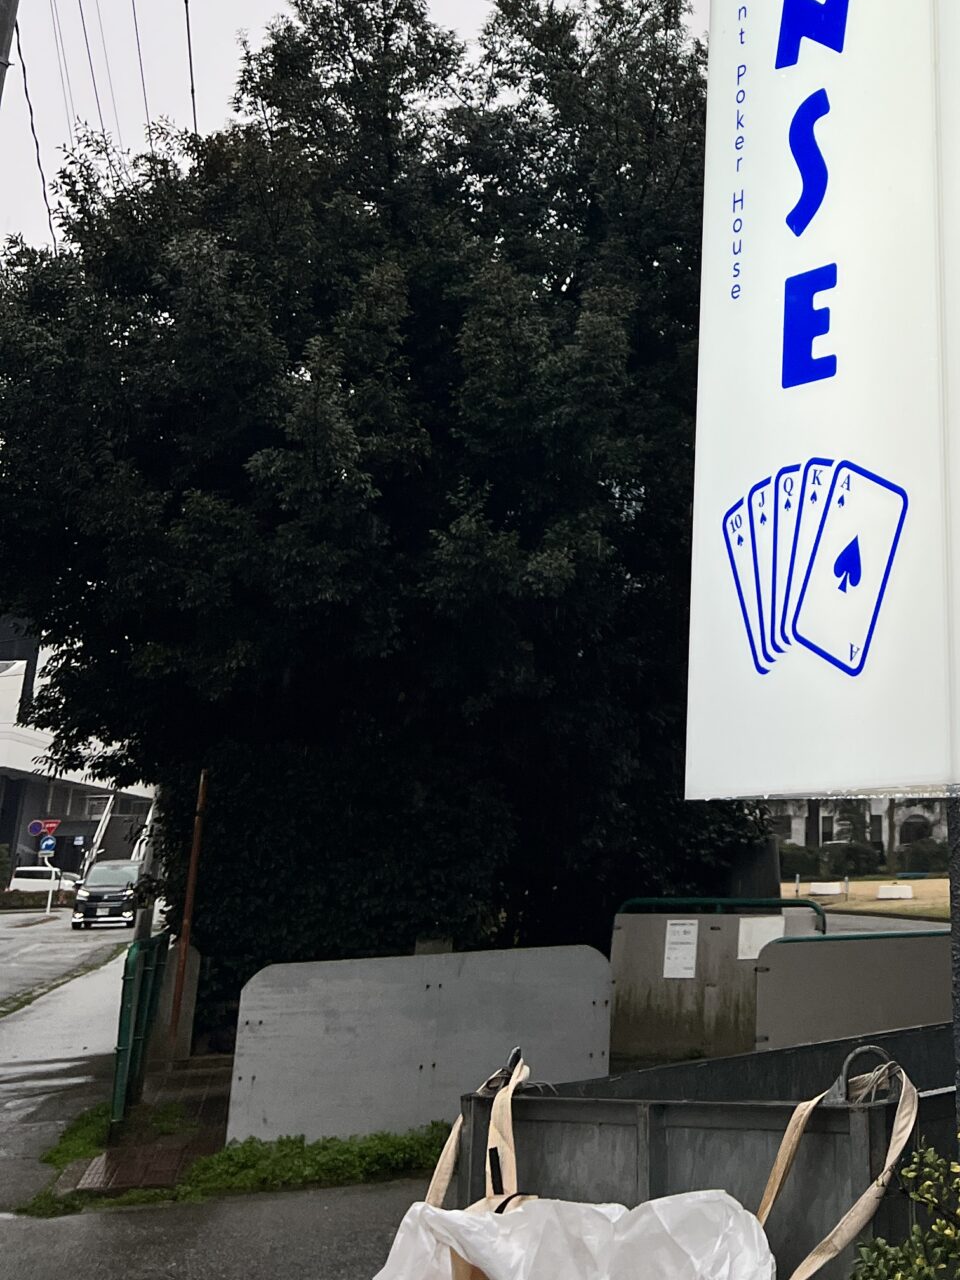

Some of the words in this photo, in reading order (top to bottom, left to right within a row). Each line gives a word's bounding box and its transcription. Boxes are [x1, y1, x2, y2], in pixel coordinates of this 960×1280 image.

[734, 64, 747, 173] Poker
[730, 188, 745, 300] House
[729, 514, 743, 533] 10
[758, 491, 765, 508] J
[783, 477, 794, 496] Q
[811, 469, 823, 486] K
[840, 474, 851, 492] A
[850, 643, 860, 662] A
